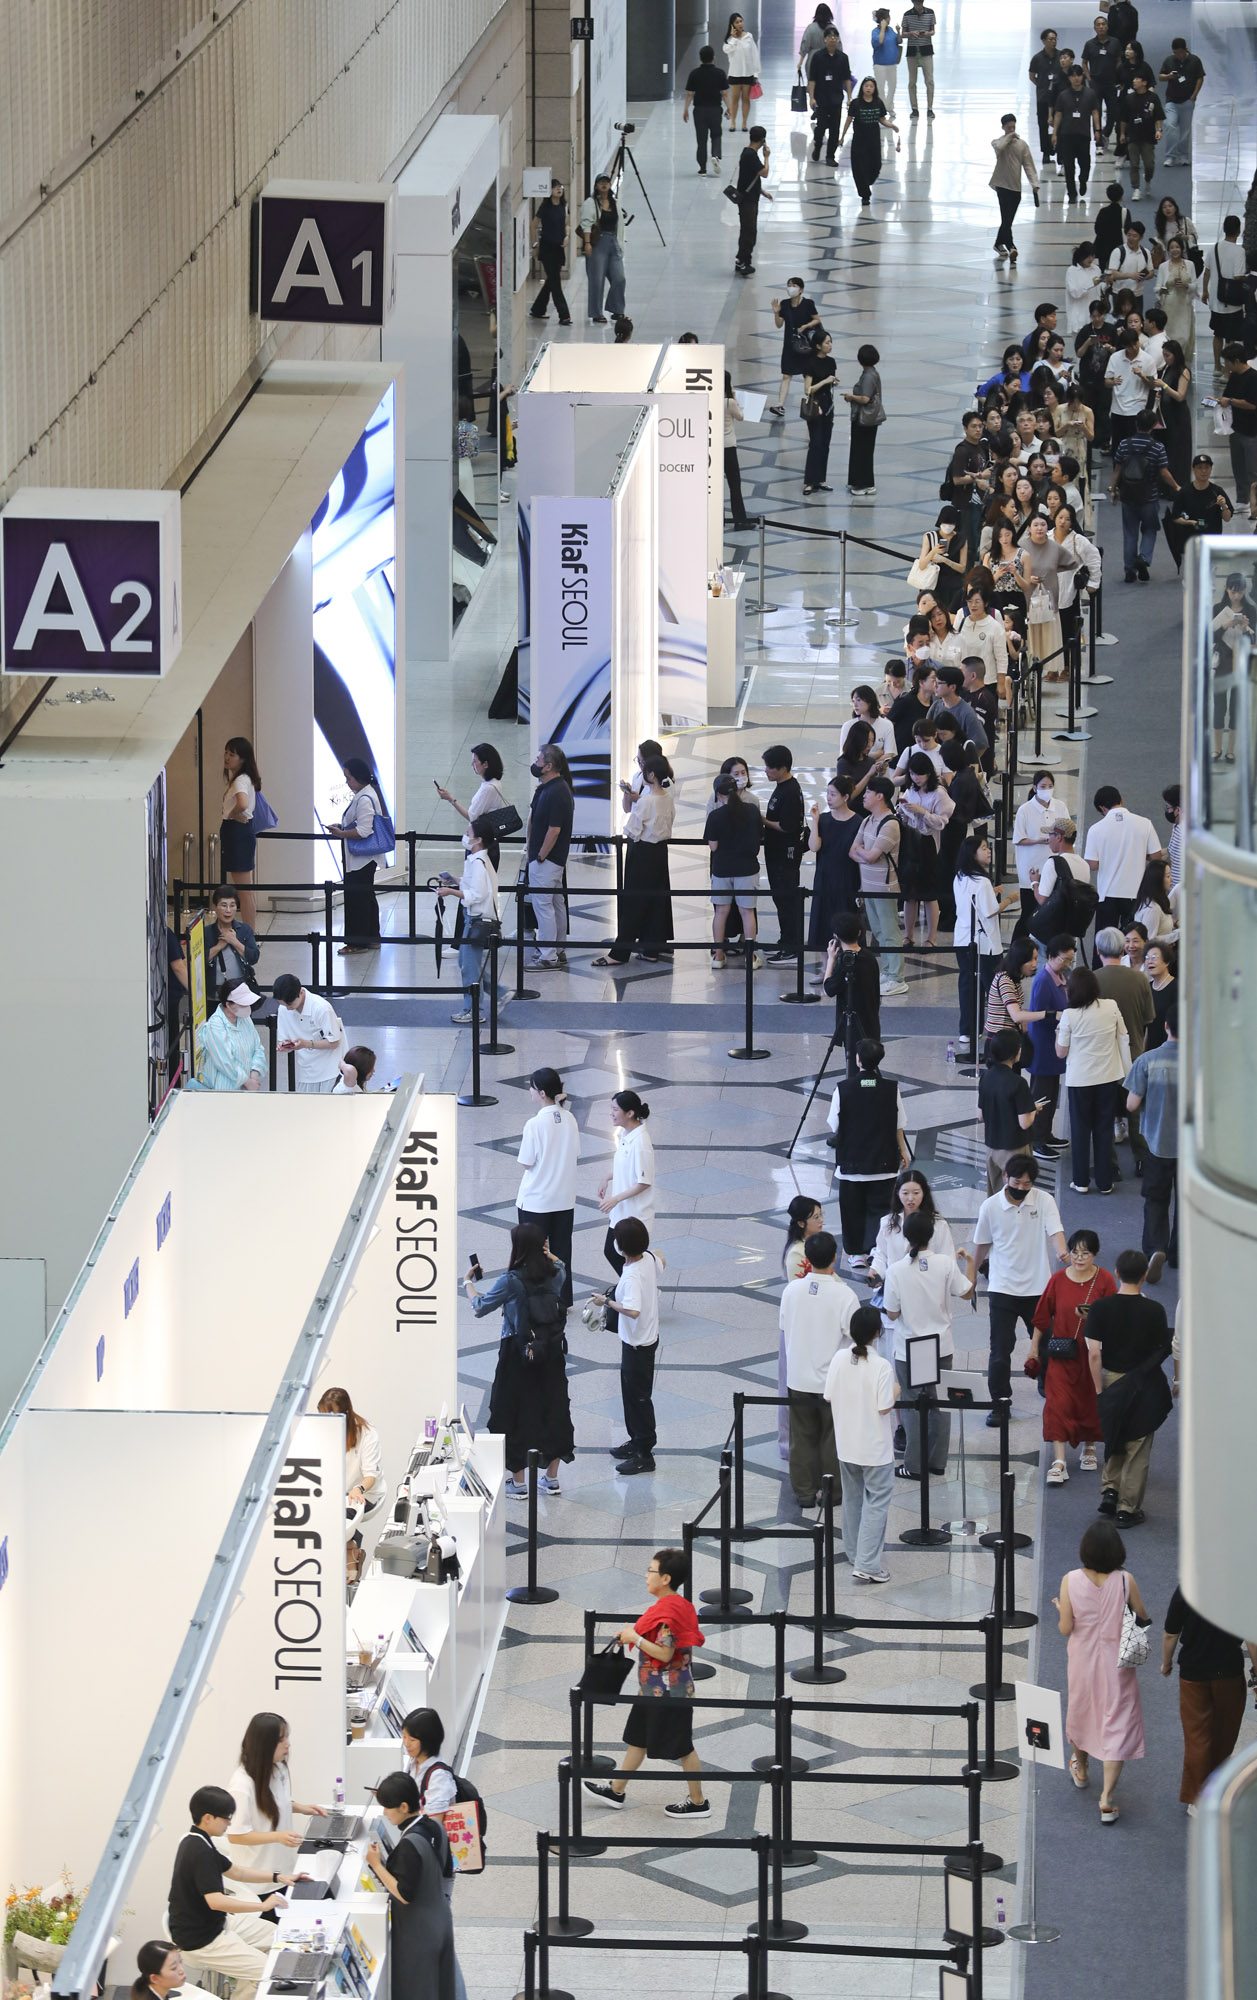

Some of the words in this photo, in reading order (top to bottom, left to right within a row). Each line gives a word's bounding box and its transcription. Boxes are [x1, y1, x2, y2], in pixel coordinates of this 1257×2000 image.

[271, 218, 373, 307] A1
[659, 463, 695, 473] DOCENT
[561, 523, 589, 574] Kiaf
[12, 542, 153, 653] A2
[561, 578, 588, 650] SEOUL
[395, 1131, 439, 1210] Kiaf
[395, 1217, 438, 1333] SEOUL
[273, 1458, 323, 1550] Kiaf
[274, 1557, 322, 1690] SEOUL
